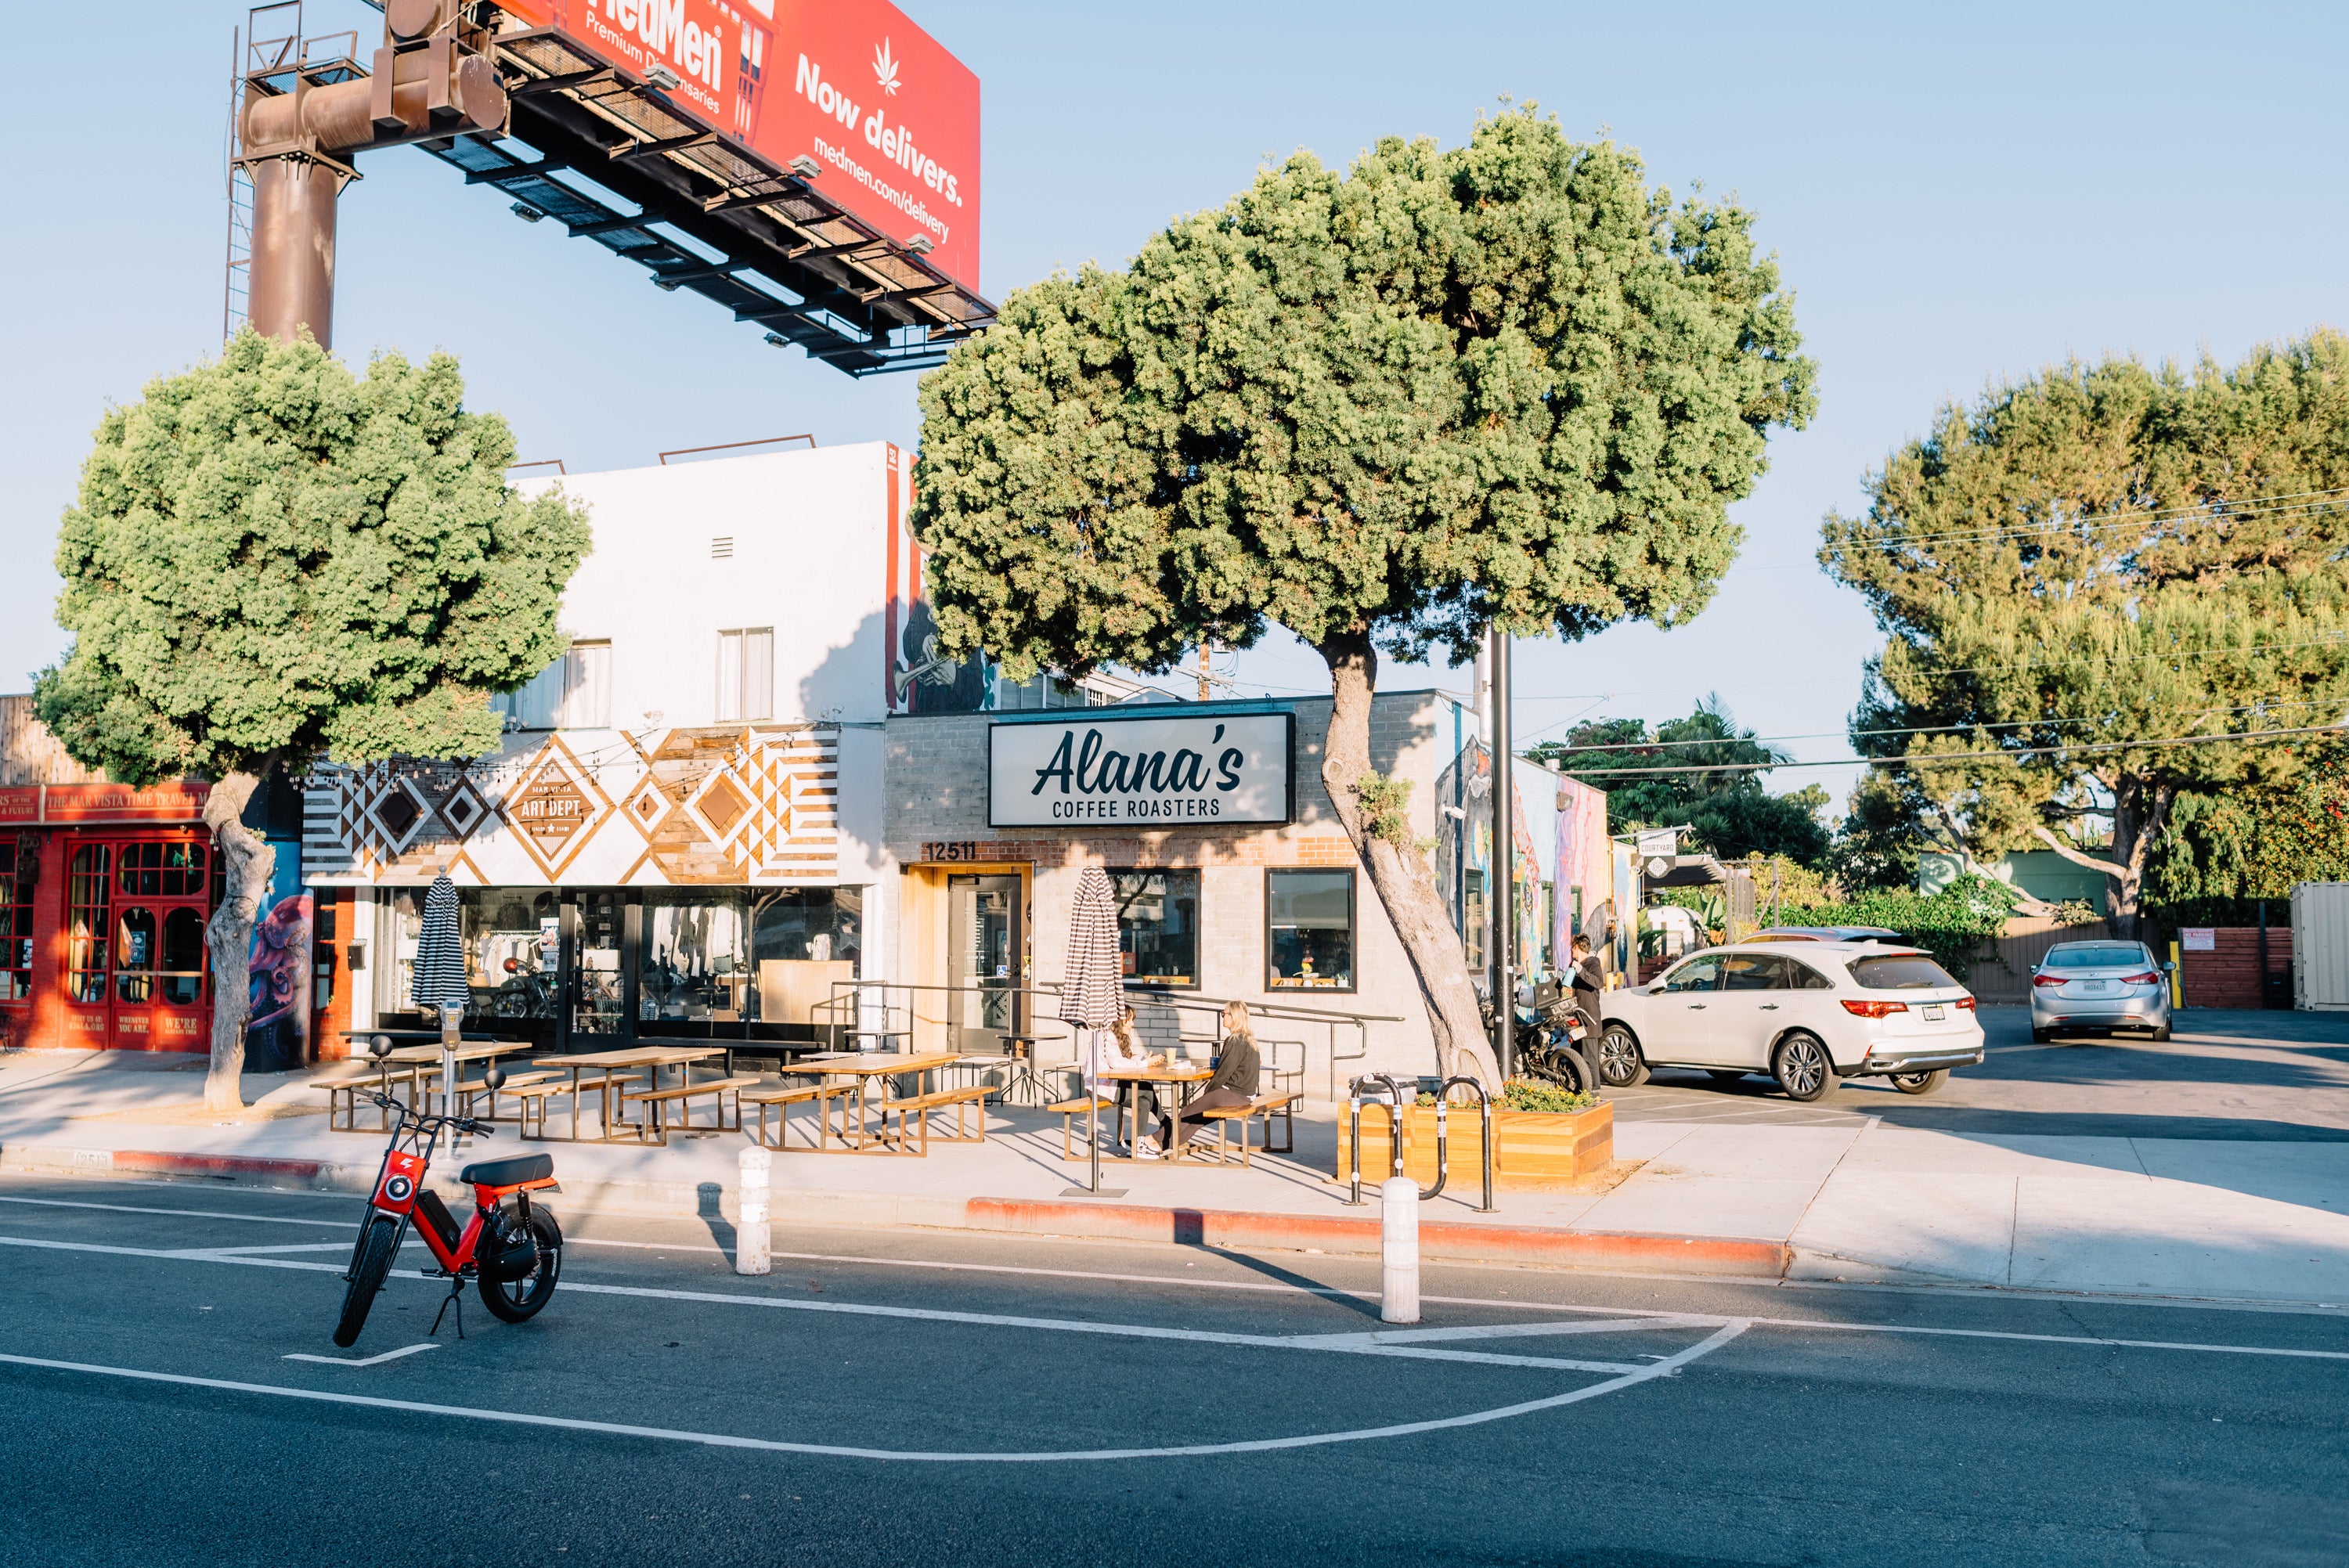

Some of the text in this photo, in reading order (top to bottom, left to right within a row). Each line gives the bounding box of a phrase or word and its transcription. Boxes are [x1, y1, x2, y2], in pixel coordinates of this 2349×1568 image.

[586, 10, 720, 114] Premium Dnsaries
[795, 52, 962, 207] Now delivers.
[814, 136, 949, 244] medmen.com/delivery
[1031, 723, 1244, 795] Alana's
[48, 795, 68, 808] THE
[69, 795, 92, 807] MAR
[93, 794, 124, 807] VISTA
[126, 793, 153, 806] TIME
[156, 792, 194, 806] TRAVEL
[521, 799, 583, 816] ART DEPT.
[1052, 798, 1220, 818] COFFEE ROASTERS
[9, 806, 34, 815] FUTURE
[926, 841, 976, 860] 12511
[119, 1024, 132, 1033] YOU
[165, 1017, 197, 1029] WE'RE
